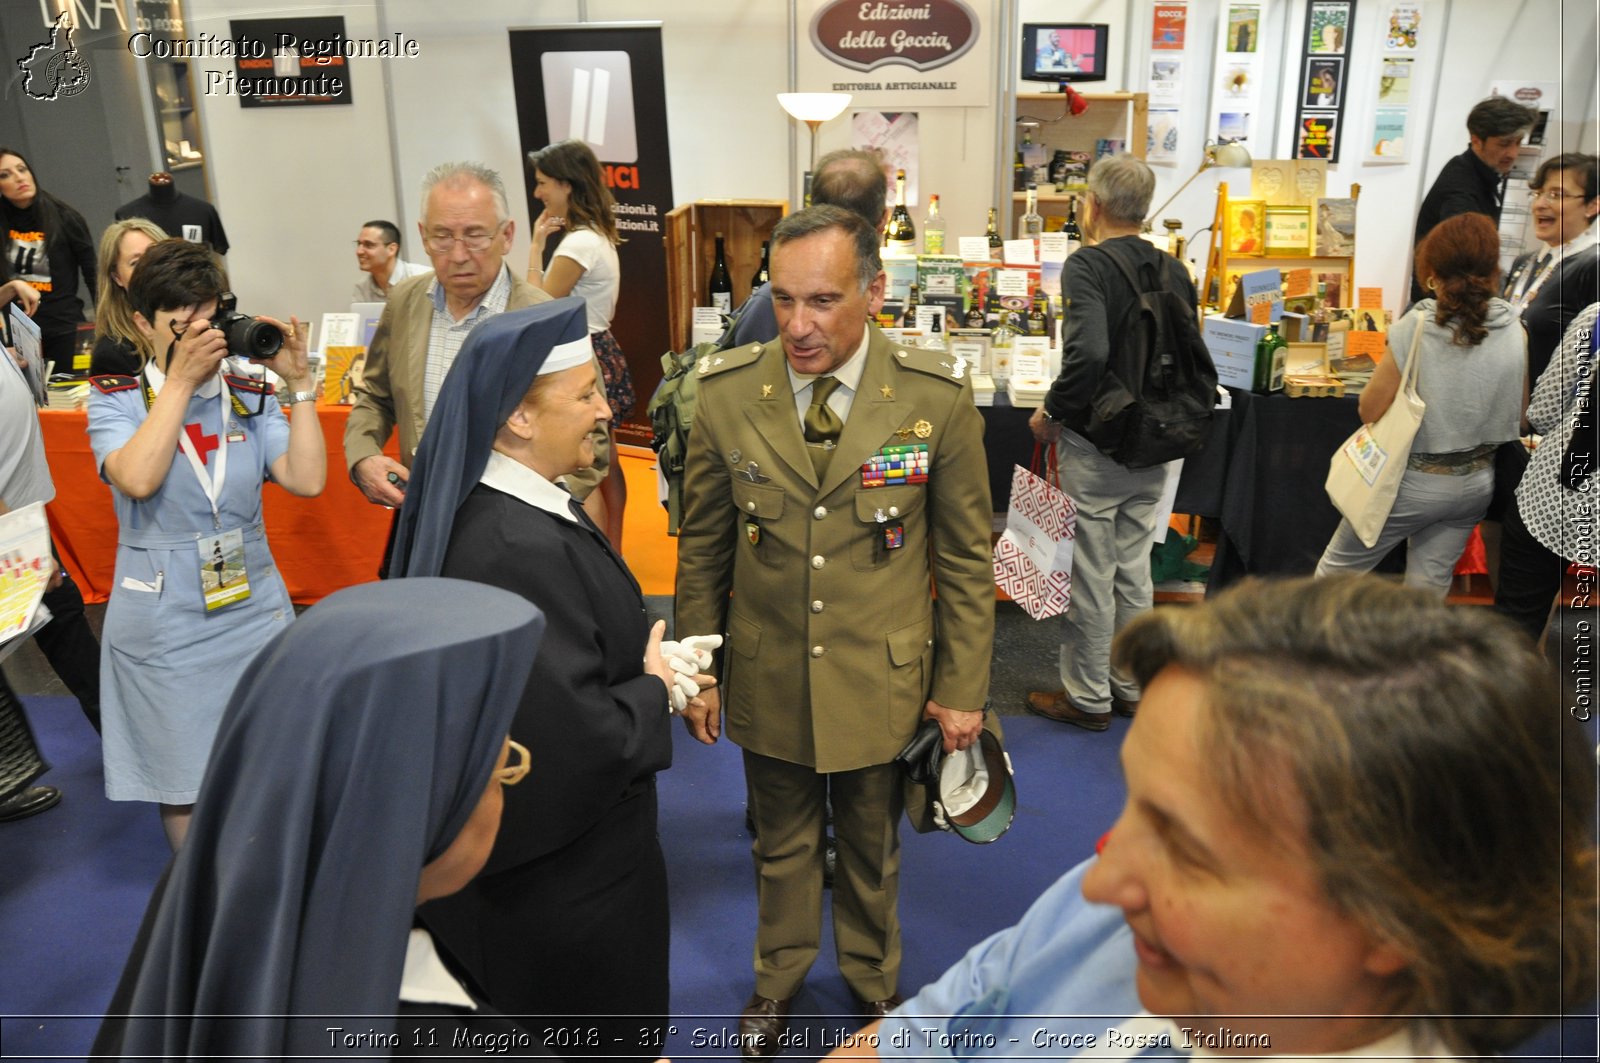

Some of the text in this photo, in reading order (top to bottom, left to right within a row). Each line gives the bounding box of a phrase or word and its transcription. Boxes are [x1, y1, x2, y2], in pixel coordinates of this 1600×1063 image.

[858, 2, 931, 21] Edizioni
[839, 28, 953, 53] della Goccia
[832, 81, 957, 91] EDITORIA ARTIGIANALE
